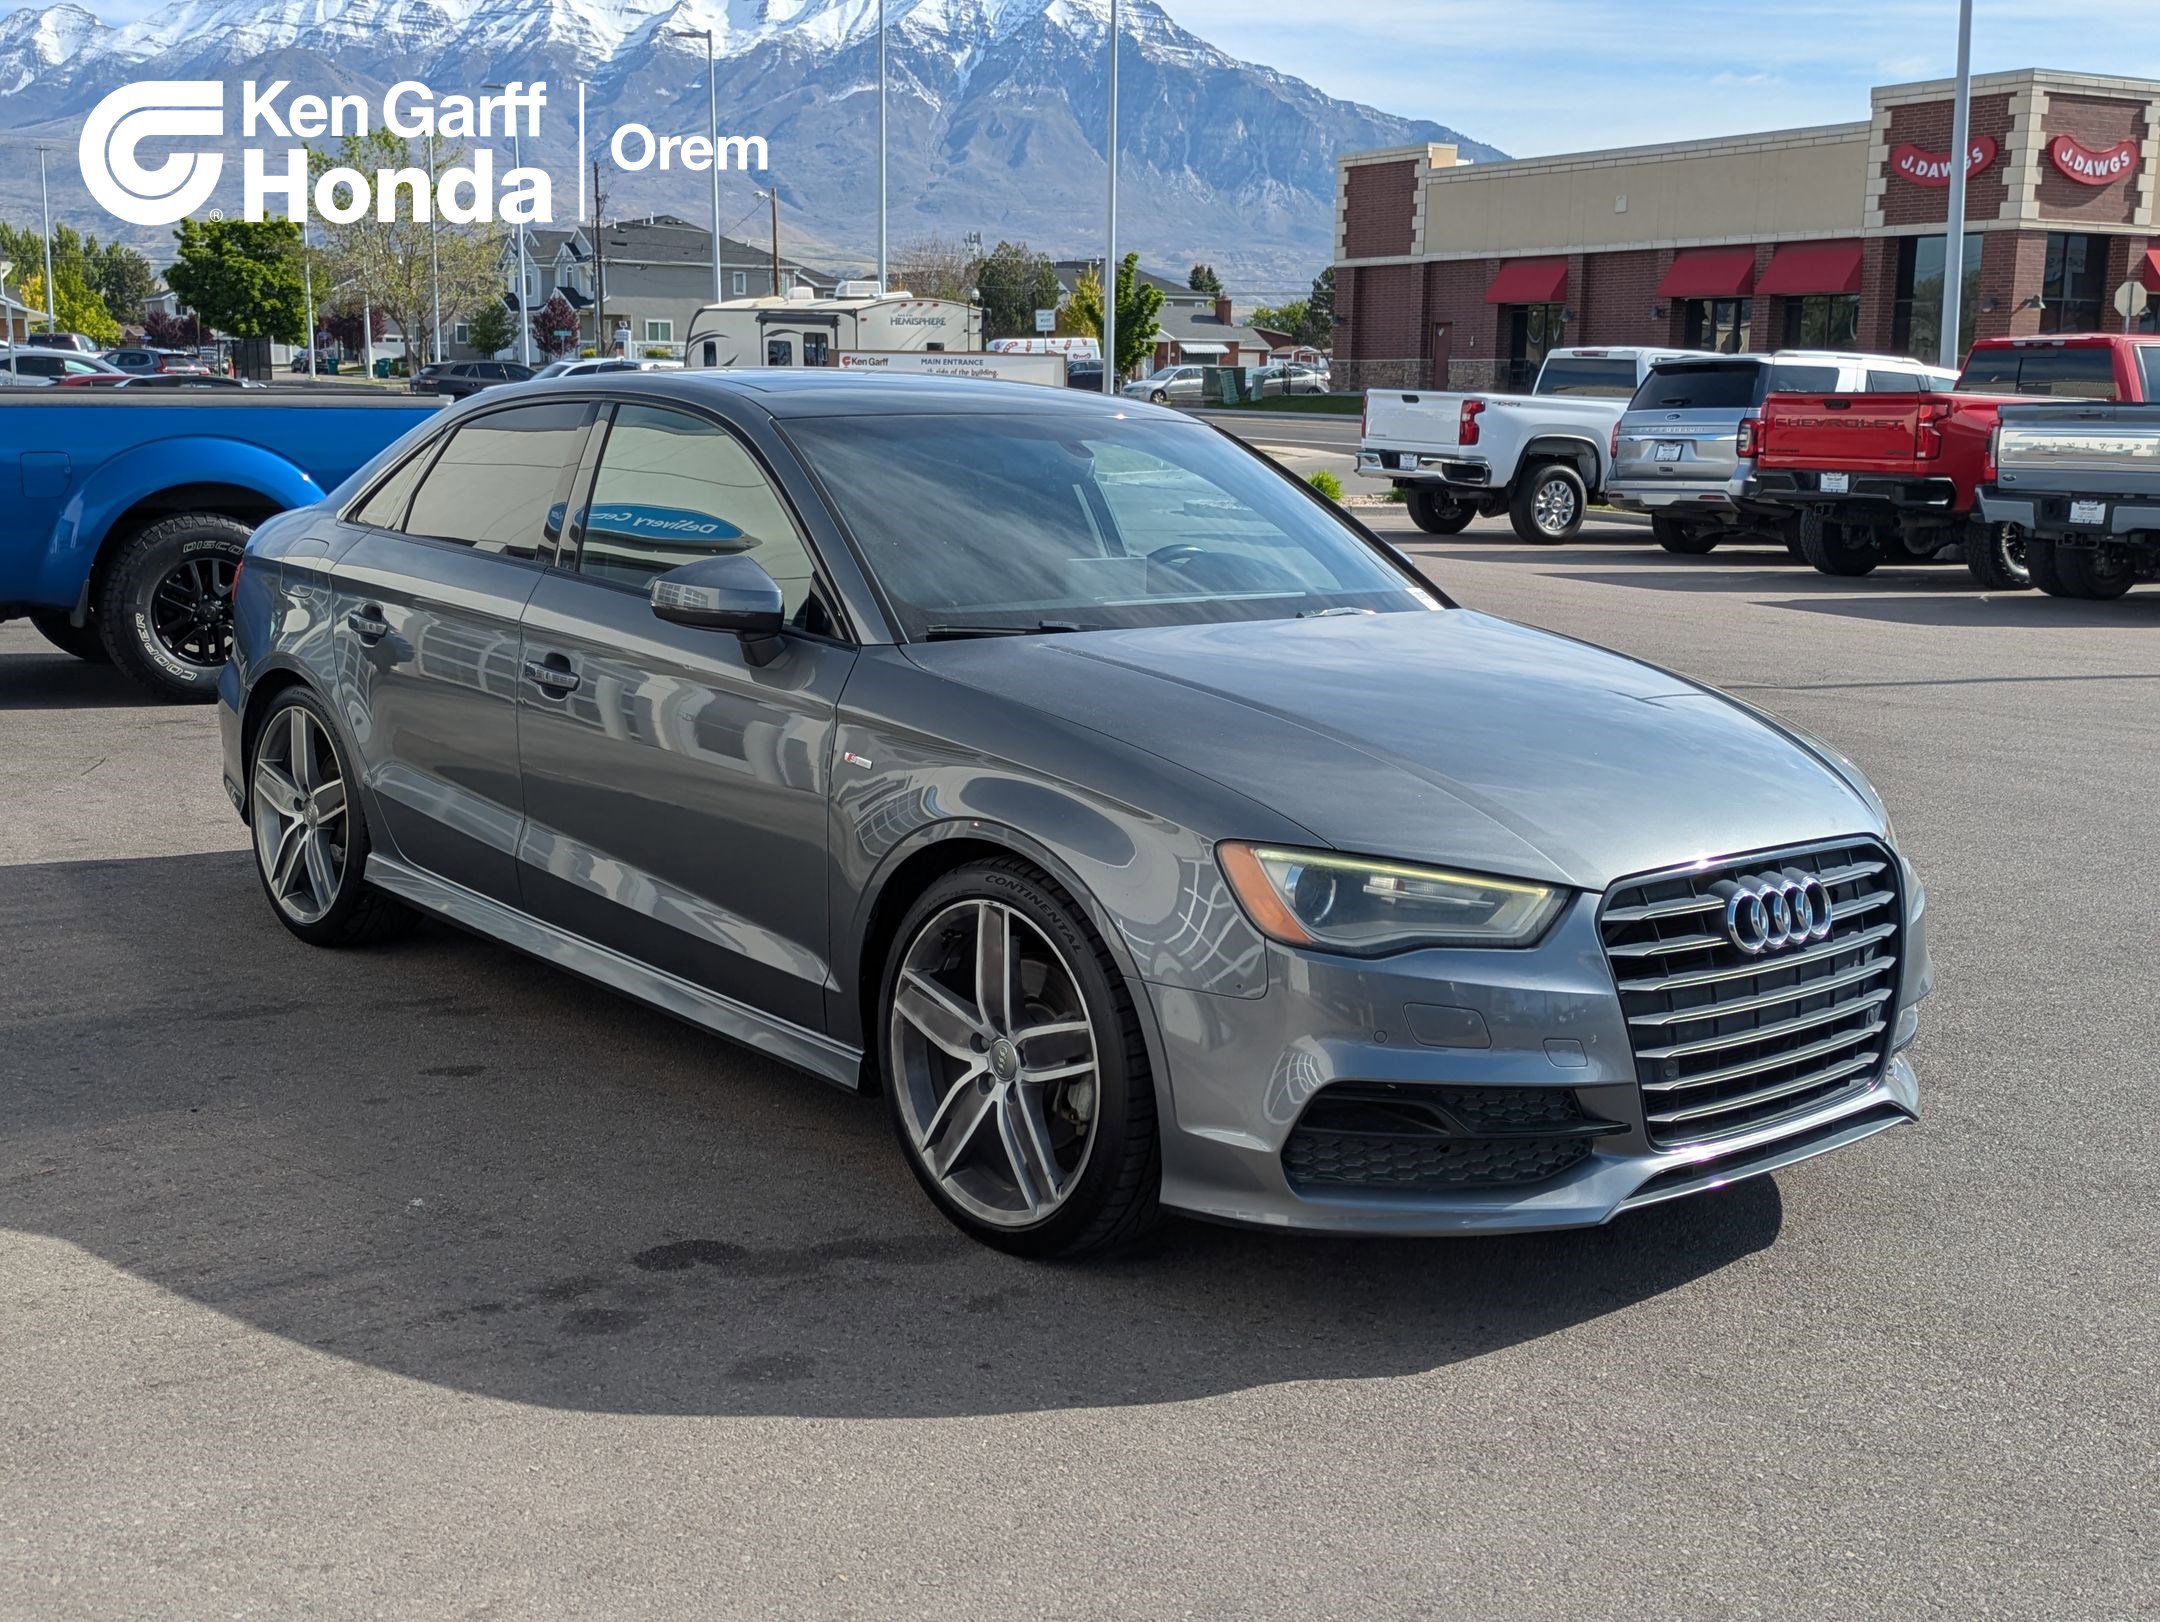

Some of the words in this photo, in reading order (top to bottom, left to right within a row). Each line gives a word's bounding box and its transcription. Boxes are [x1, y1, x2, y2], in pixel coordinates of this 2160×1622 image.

[2061, 148, 2130, 176] J.DAWGS
[890, 316, 947, 326] HEMISPHERE
[851, 356, 868, 366] Ken
[868, 357, 889, 367] Garff
[920, 358, 941, 366] MAIN
[943, 358, 985, 367] ENTRANCE
[958, 368, 970, 376] the
[1775, 417, 1905, 430] CHEVROLET
[134, 612, 198, 681] COOPER
[984, 874, 1083, 954] CONTINENTAL
